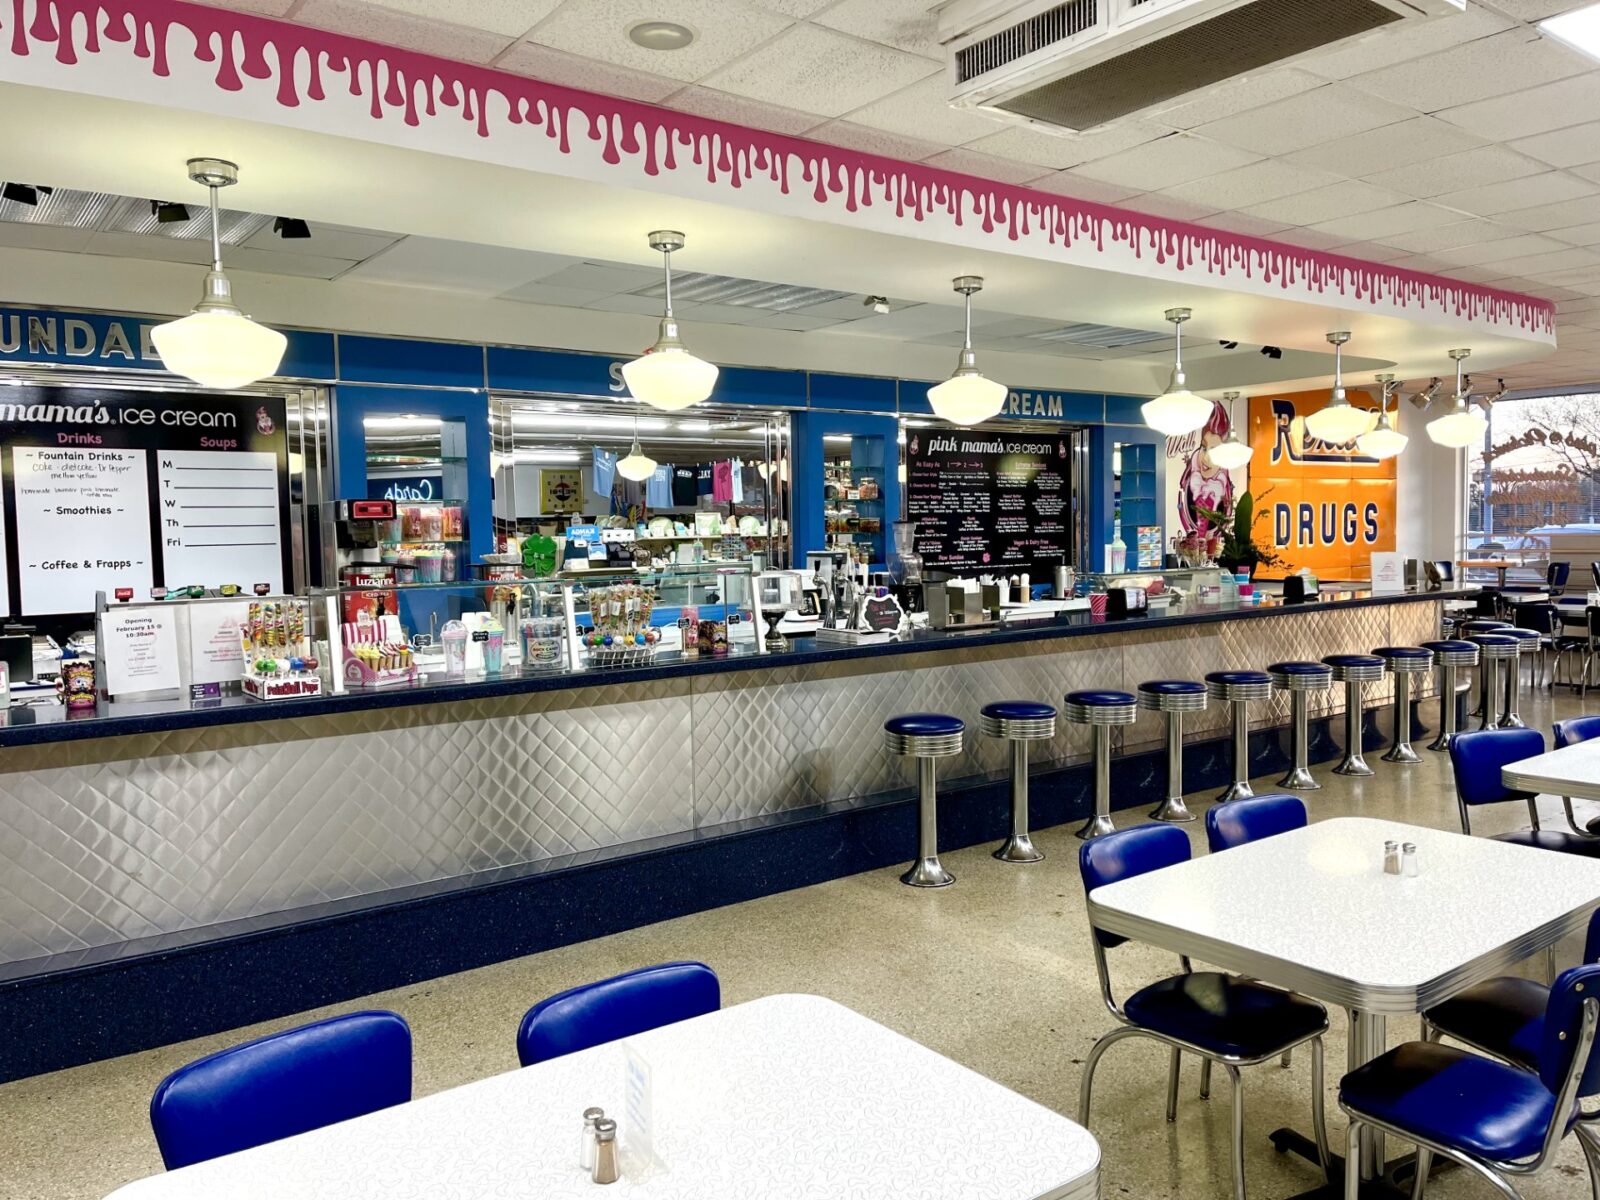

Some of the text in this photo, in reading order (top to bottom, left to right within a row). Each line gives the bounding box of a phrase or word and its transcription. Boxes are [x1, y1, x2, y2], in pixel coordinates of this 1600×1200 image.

[160, 410, 237, 428] cream
[57, 433, 103, 445] Drinks
[200, 437, 238, 450] Soups
[928, 436, 957, 456] pink
[961, 438, 1004, 453] mama's
[1022, 443, 1052, 454] cream
[38, 451, 123, 461] Fountain Drinks
[162, 461, 173, 469] M
[164, 480, 171, 488] T
[56, 505, 112, 515] Smoothies
[166, 519, 179, 527] Th
[1274, 501, 1378, 550] DRUGS
[167, 538, 181, 547] Fri
[41, 559, 132, 571] Coffee & Frapps
[116, 625, 145, 633] February
[302, 682, 319, 694] Pops
